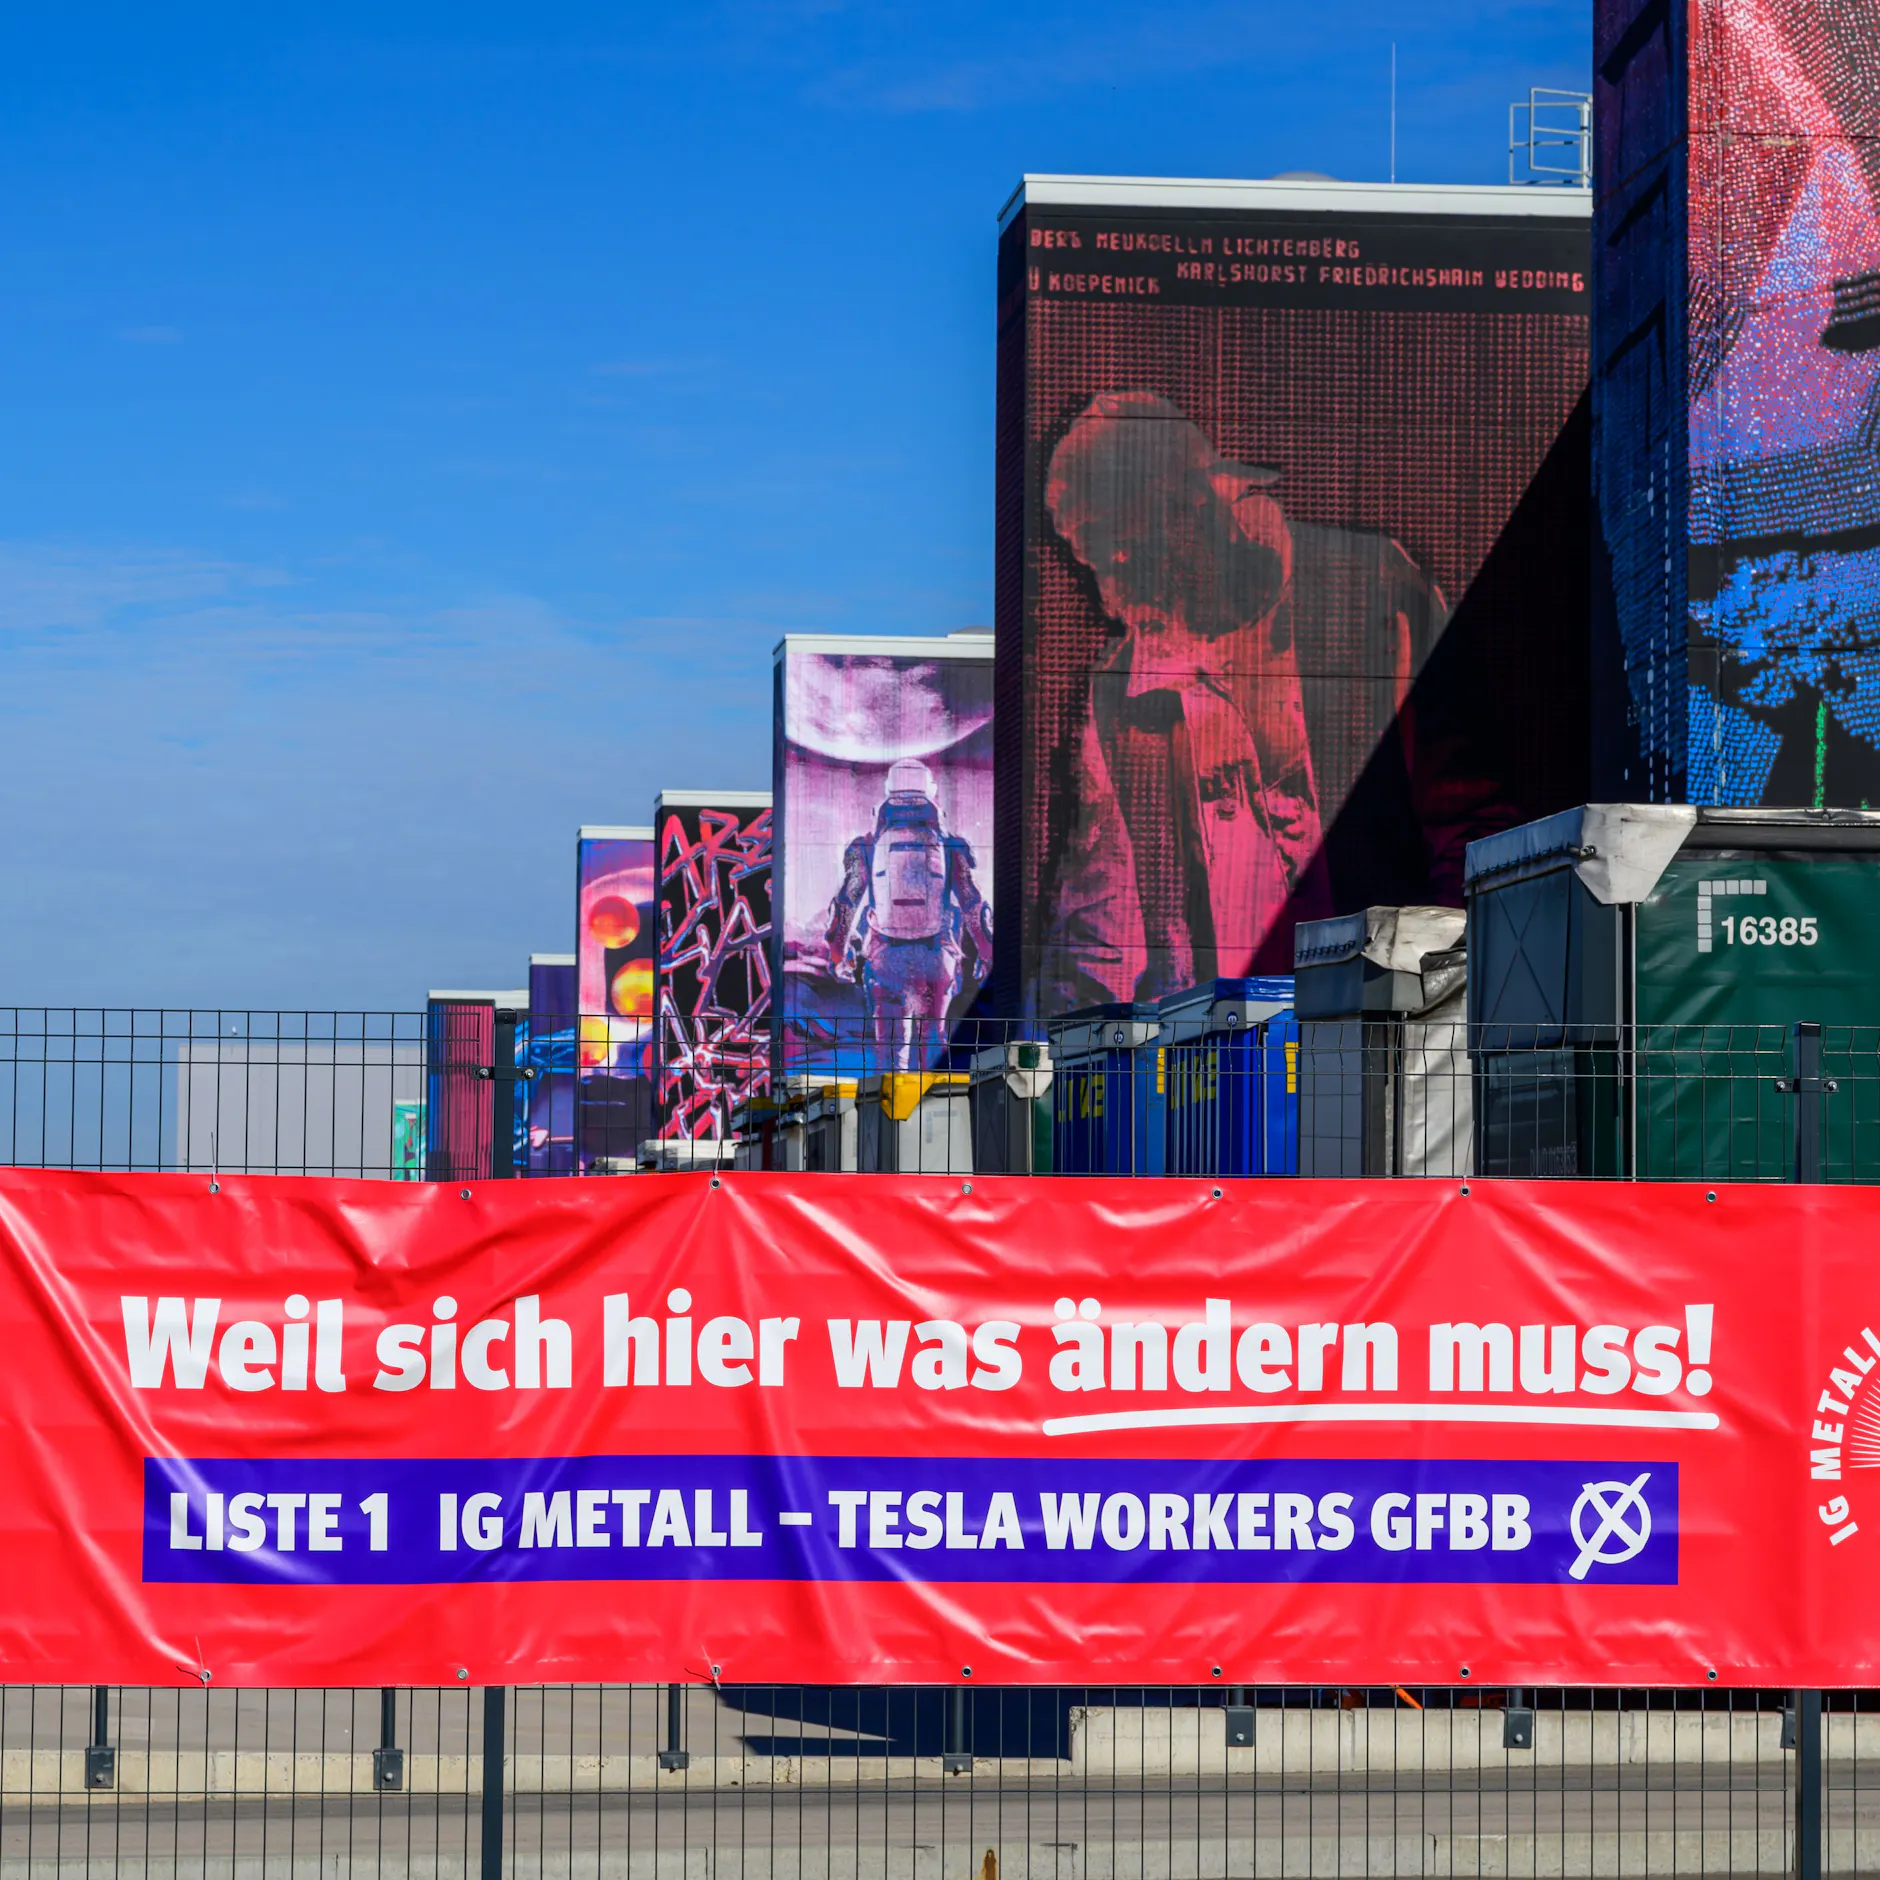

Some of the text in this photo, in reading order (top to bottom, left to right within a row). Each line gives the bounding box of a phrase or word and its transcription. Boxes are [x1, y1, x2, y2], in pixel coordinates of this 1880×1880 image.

[1177, 261, 1308, 285] KARLSHORST
[1319, 265, 1484, 288] FRIEDRICHSHAIN
[1721, 916, 1819, 946] 16385
[120, 1288, 1714, 1397] Weil sich hier was ändern muss!
[169, 1492, 342, 1552] LISTE
[360, 1493, 388, 1551] 1
[440, 1492, 503, 1551] IG
[519, 1489, 763, 1549] METALL
[828, 1490, 1025, 1551] TESLA
[1040, 1492, 1354, 1551] WORKERS
[1370, 1492, 1531, 1551] GFBB
[1818, 1494, 1859, 1546] IG
